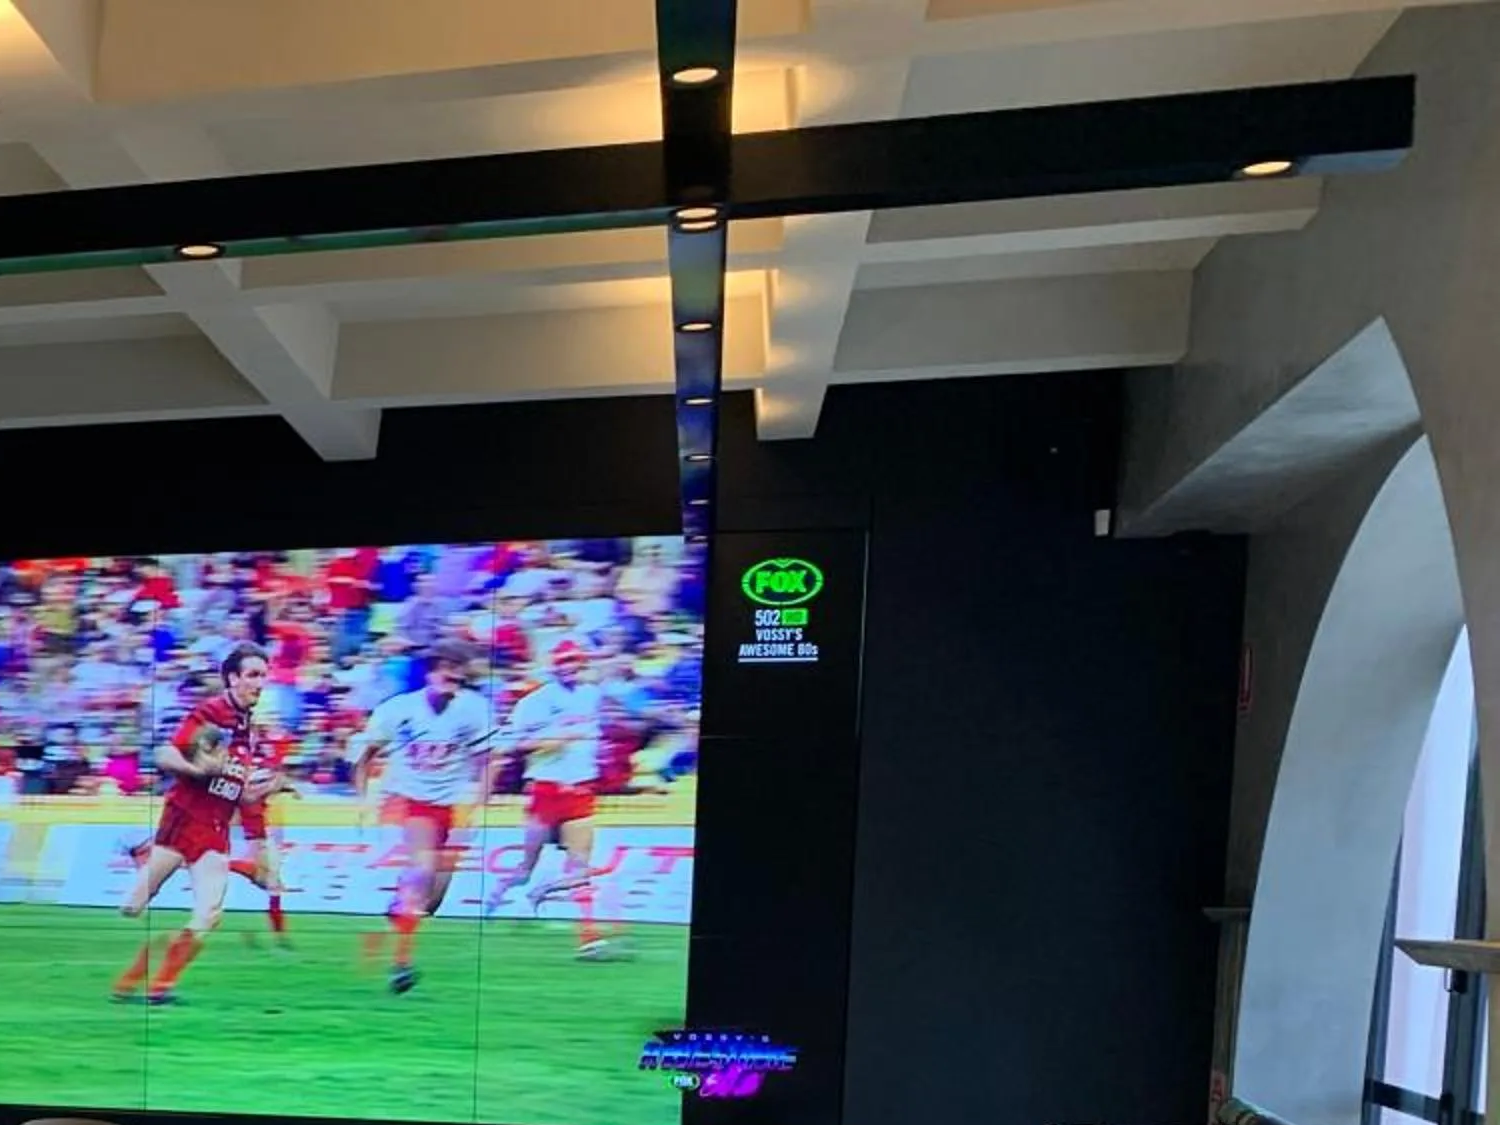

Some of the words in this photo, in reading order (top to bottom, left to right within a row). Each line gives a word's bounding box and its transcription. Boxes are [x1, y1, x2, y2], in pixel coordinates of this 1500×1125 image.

[755, 570, 808, 593] FOX
[755, 609, 781, 626] 502
[755, 628, 803, 641] VOSSY'S
[738, 643, 795, 657] AWESOME
